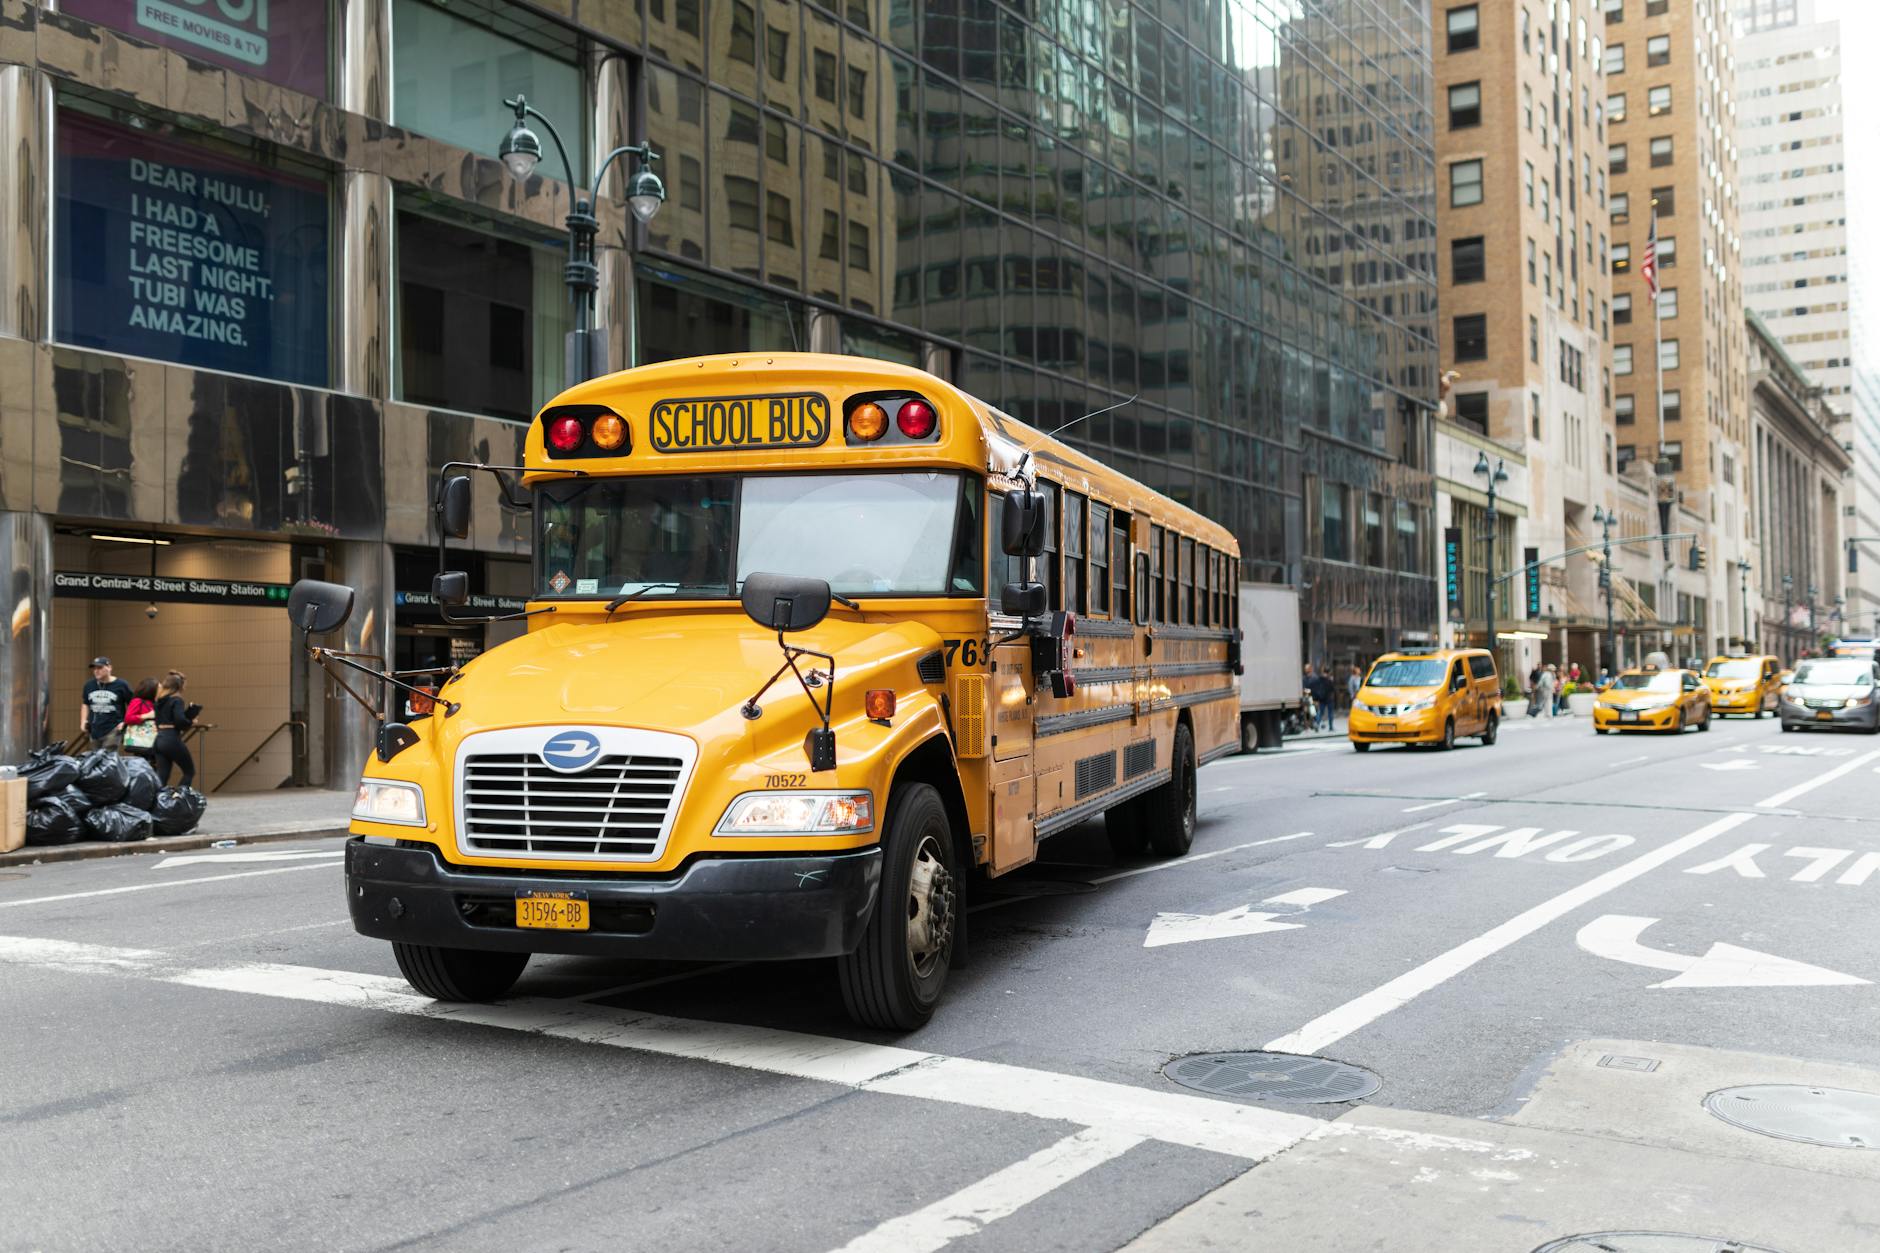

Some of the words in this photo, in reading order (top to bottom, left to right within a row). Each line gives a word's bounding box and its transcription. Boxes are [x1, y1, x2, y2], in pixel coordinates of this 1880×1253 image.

[145, 5, 179, 27] FREE
[182, 18, 232, 46] MOVIES
[234, 37, 242, 49] &
[245, 41, 262, 56] TV
[130, 157, 197, 196] DEAR
[203, 177, 269, 218] HULU,
[131, 193, 138, 217] I
[145, 196, 198, 230] HAD
[203, 213, 221, 236] A
[130, 220, 259, 271] FREESOME
[130, 247, 194, 283] LAST
[201, 263, 275, 301] NIGHT.
[128, 275, 186, 309] TUBI
[193, 288, 246, 320] WAS
[128, 304, 248, 347] AMAZING.
[656, 400, 762, 448] SCHOOL
[769, 397, 824, 442] BUS
[55, 574, 89, 587] Grand
[153, 579, 186, 592] Street
[189, 581, 228, 596] Subway
[230, 583, 265, 596] Station
[404, 592, 429, 604] Grand
[472, 596, 496, 607] Street
[498, 597, 525, 610] Subway
[943, 638, 988, 668] 763
[764, 774, 807, 788] 70522
[1326, 822, 1635, 863] ONLY
[533, 891, 550, 899] NEW
[551, 892, 570, 900] YORK
